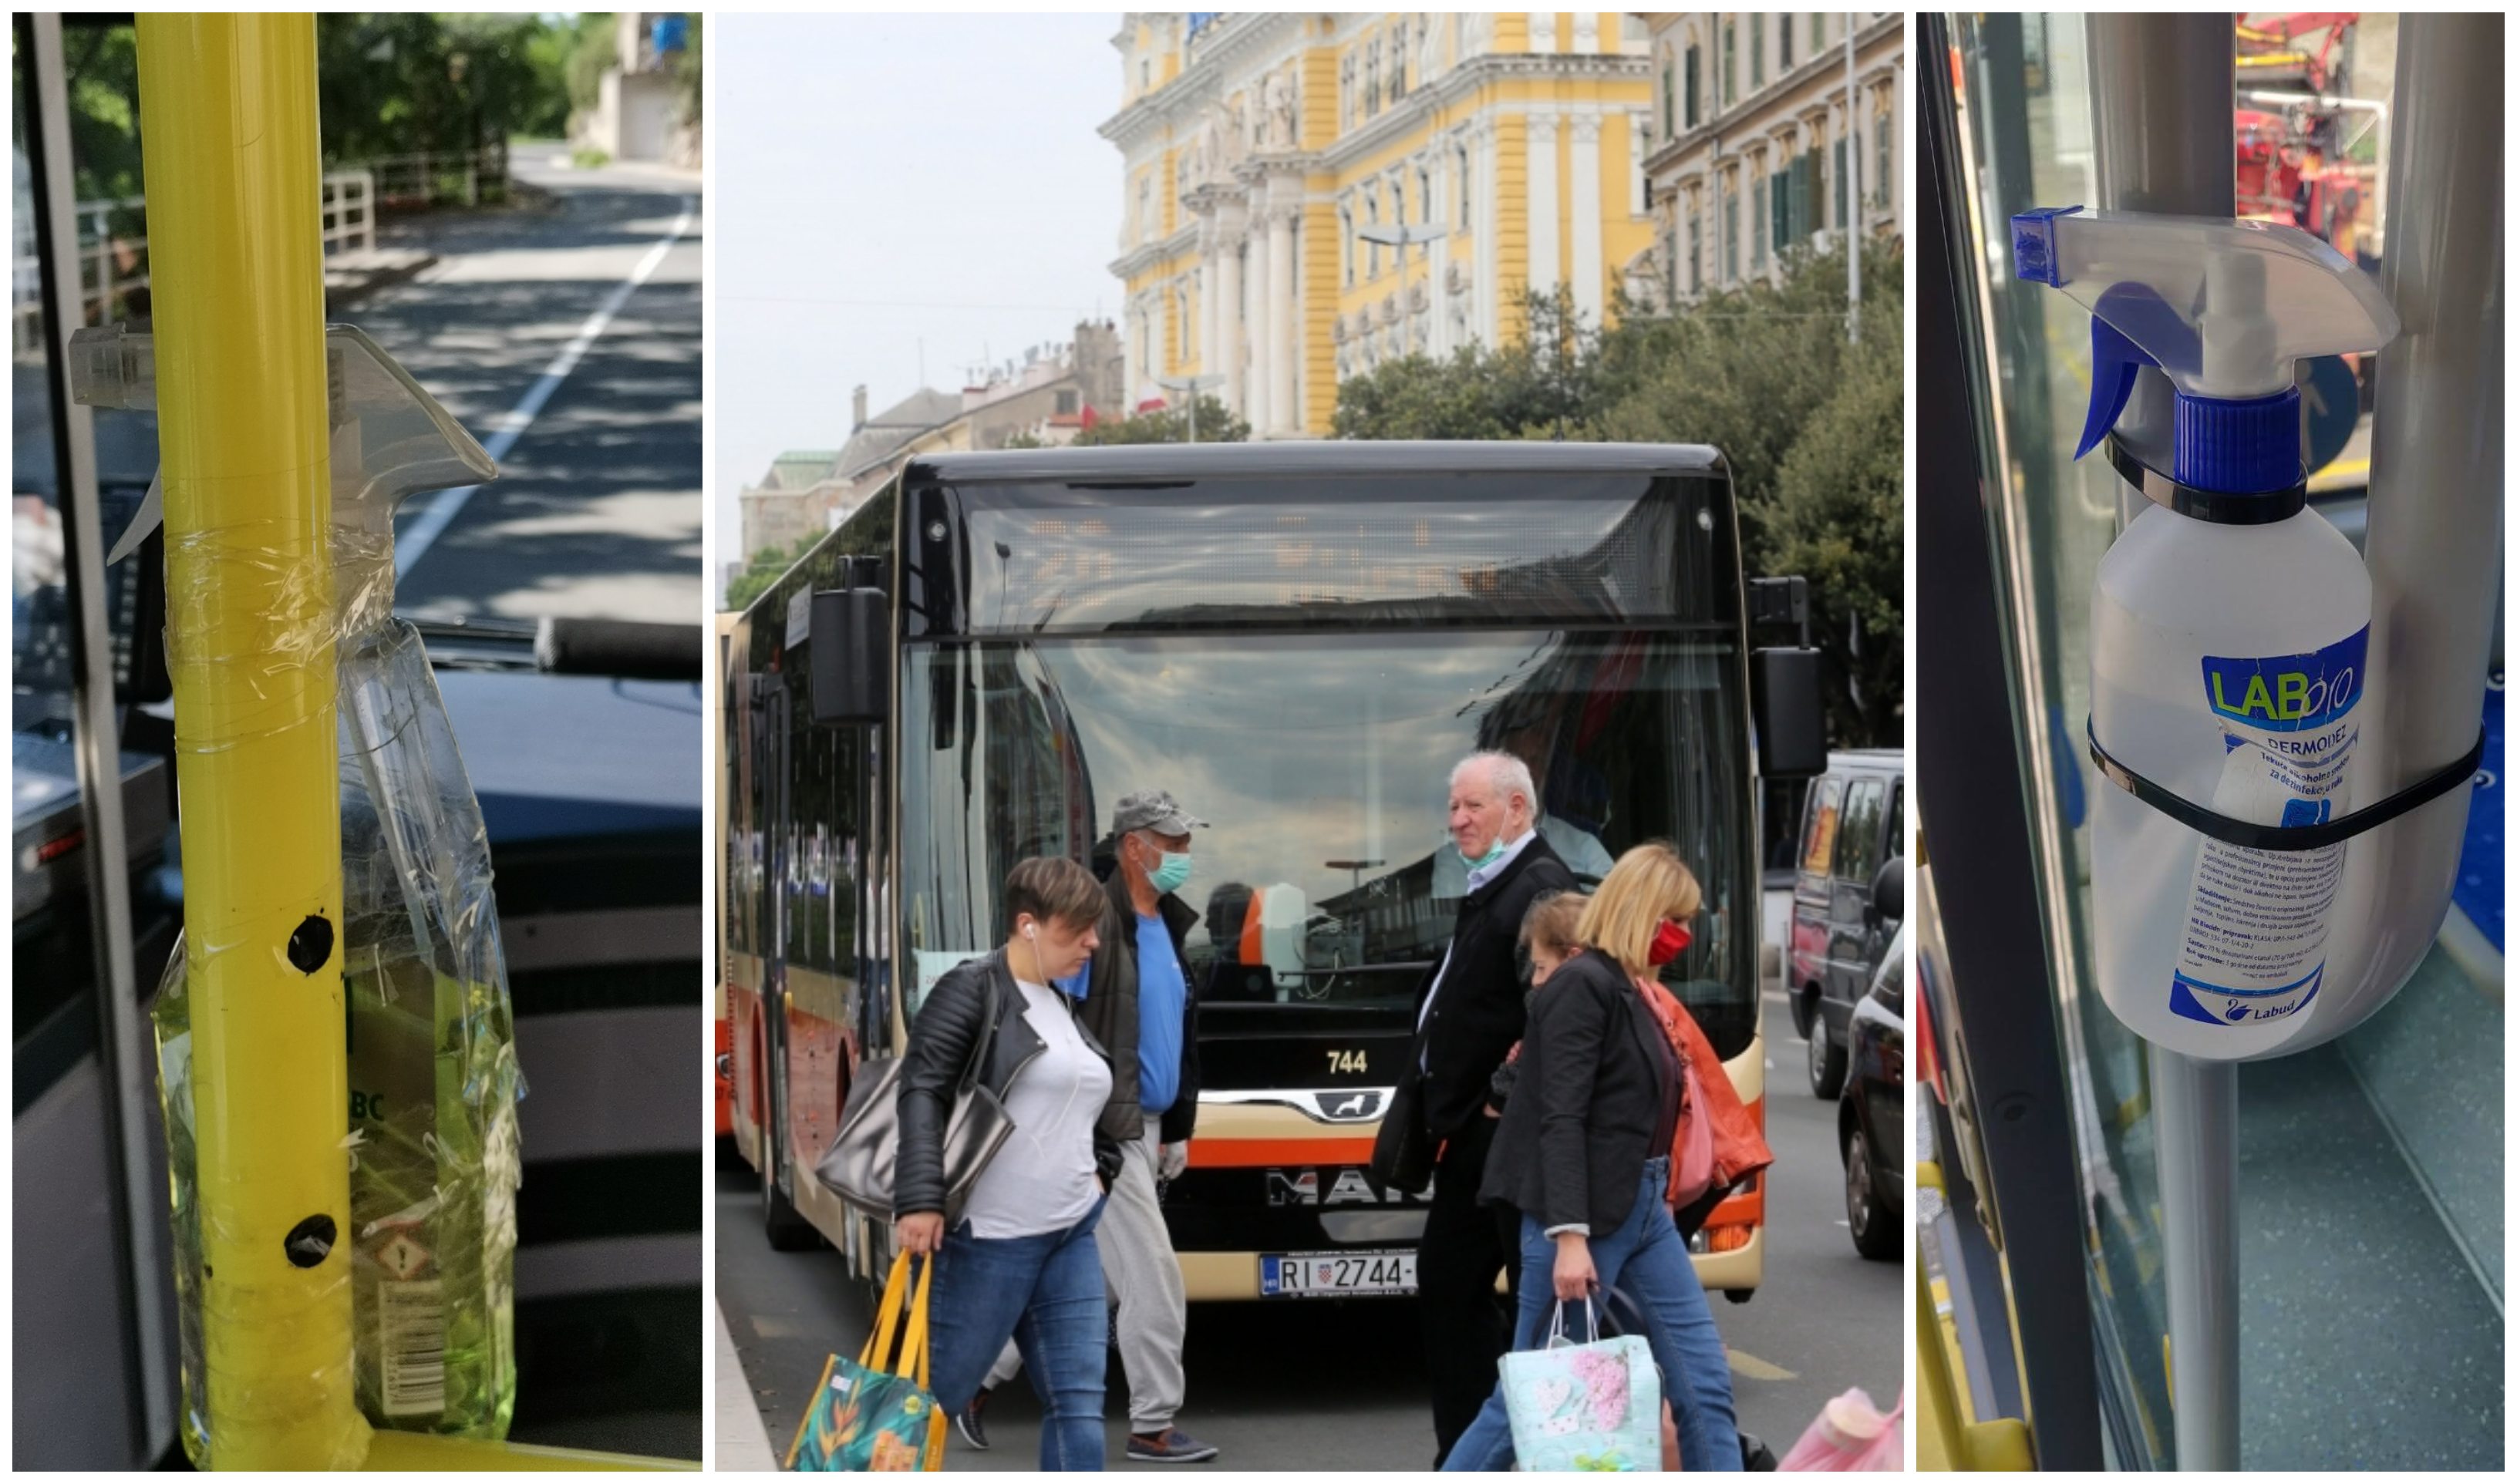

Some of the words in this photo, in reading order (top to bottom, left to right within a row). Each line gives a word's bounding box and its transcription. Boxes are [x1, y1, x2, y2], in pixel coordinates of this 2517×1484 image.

[2269, 769, 2279, 779] za
[2200, 920, 2221, 933] Biocidn
[2254, 999, 2296, 1020] Labud
[1326, 1050, 1367, 1074] 744
